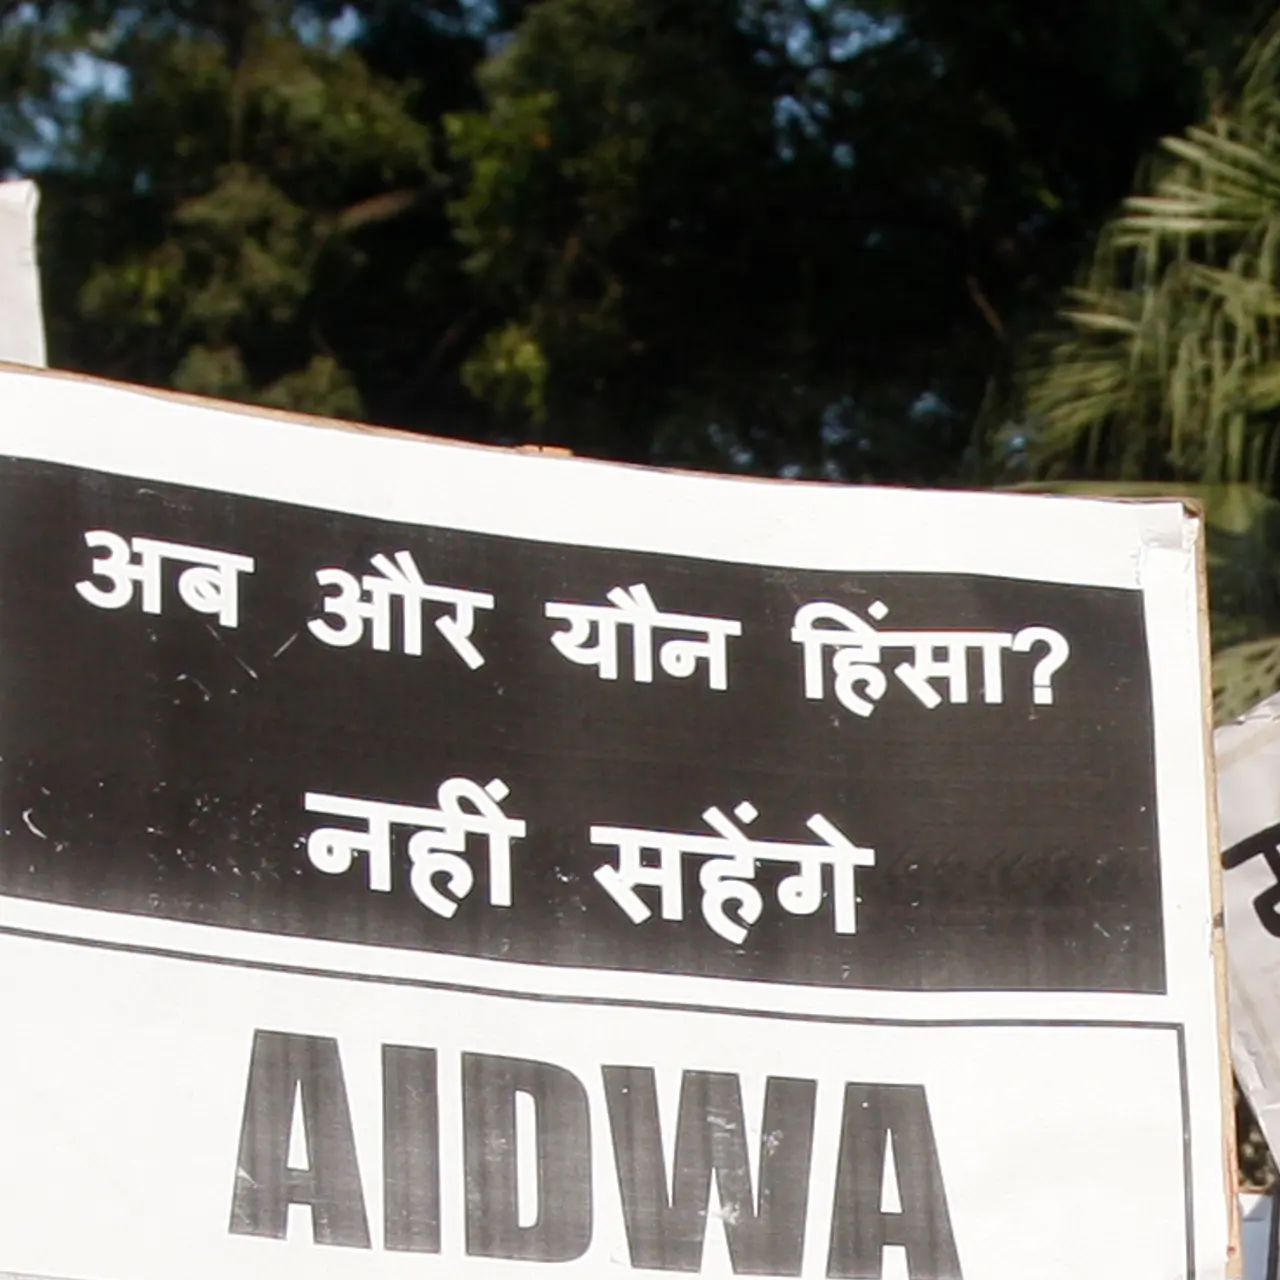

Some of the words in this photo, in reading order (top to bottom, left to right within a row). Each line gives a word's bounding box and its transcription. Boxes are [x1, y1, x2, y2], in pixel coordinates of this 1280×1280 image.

[76, 527, 254, 629] अब
[307, 551, 495, 670] और
[546, 583, 742, 692] यौन
[791, 601, 1071, 718] हिंसा?
[304, 777, 527, 918] नहीं
[589, 800, 876, 945] सहेंगे
